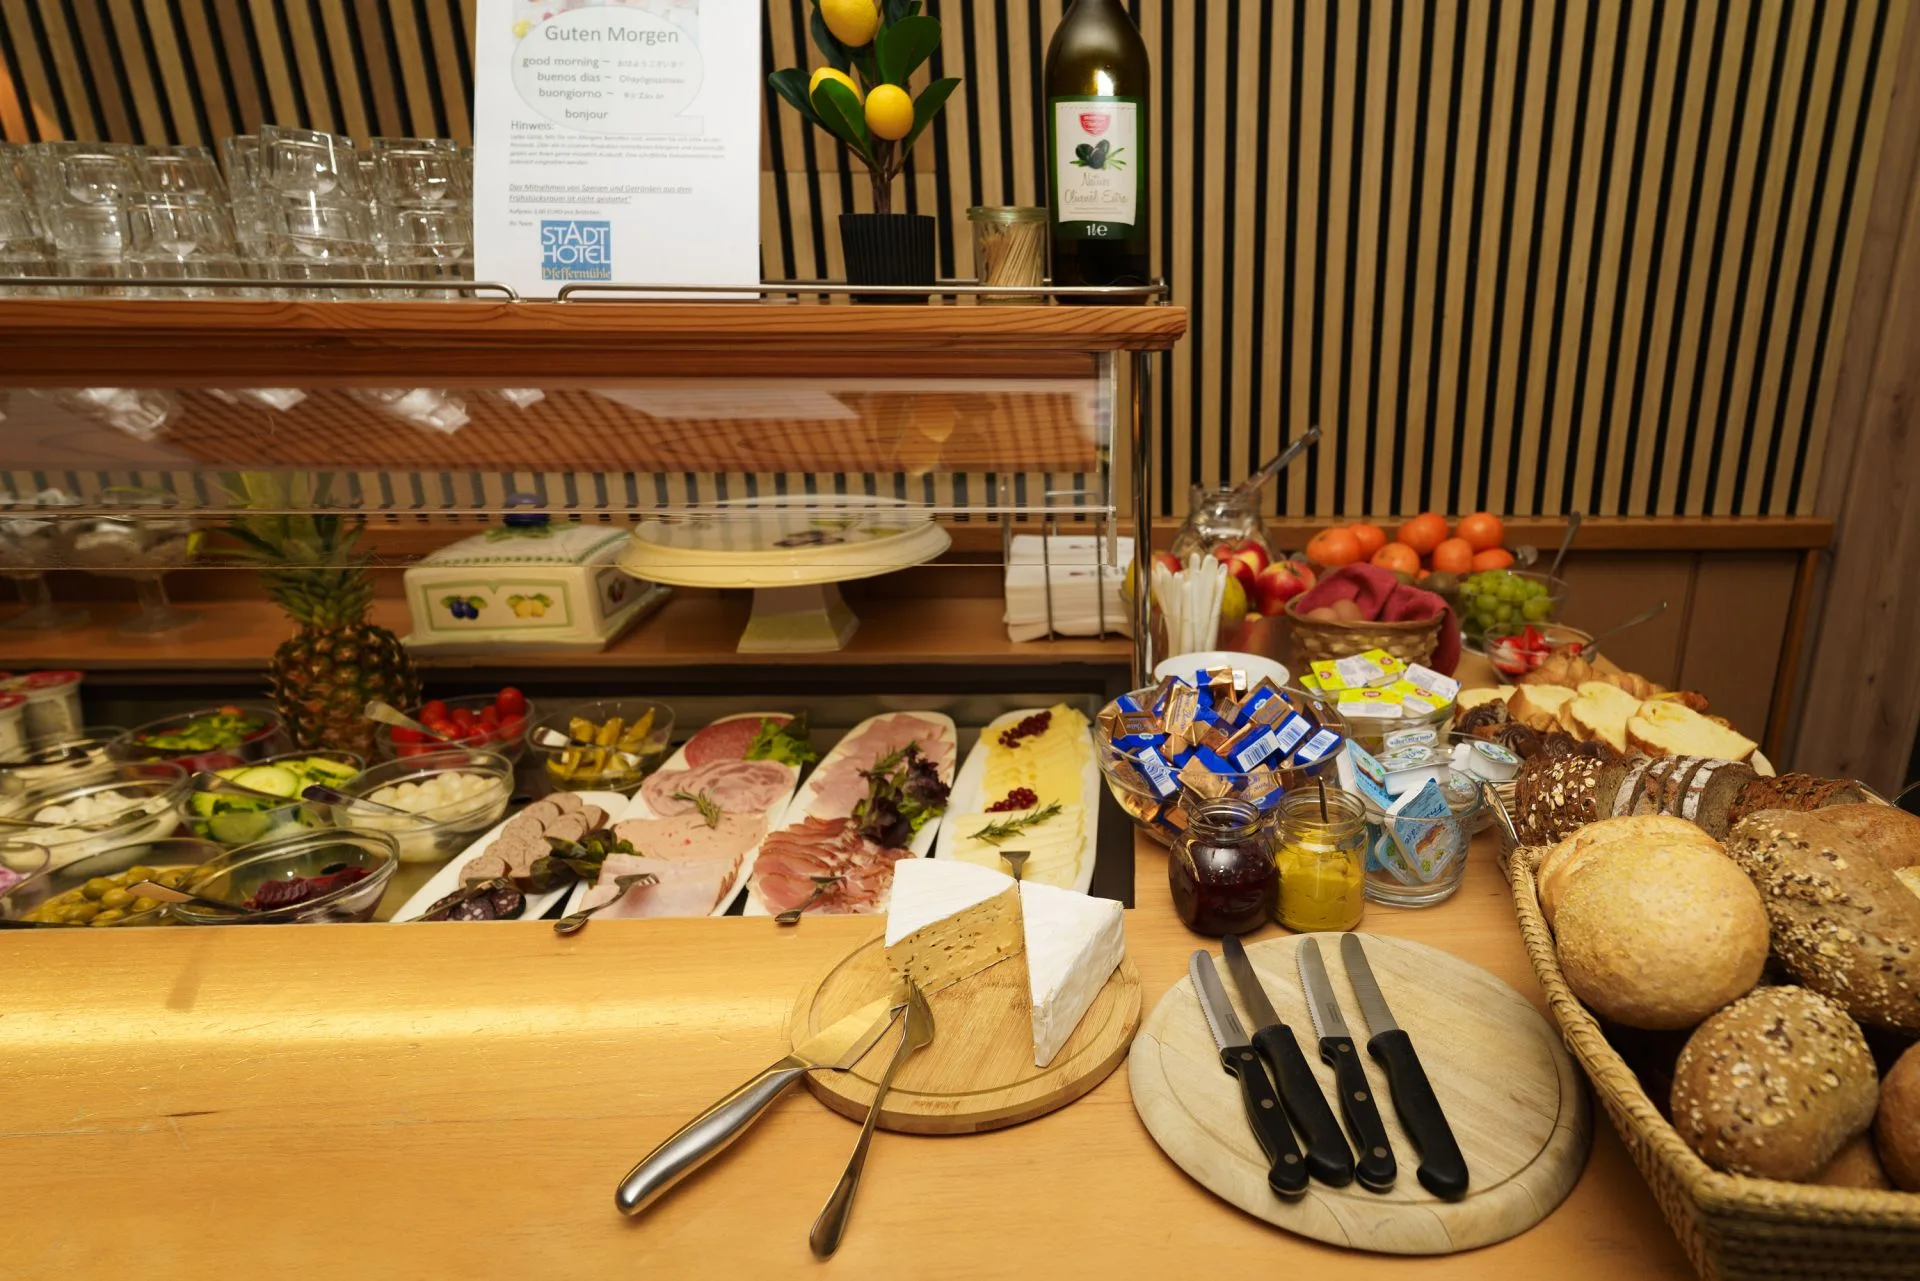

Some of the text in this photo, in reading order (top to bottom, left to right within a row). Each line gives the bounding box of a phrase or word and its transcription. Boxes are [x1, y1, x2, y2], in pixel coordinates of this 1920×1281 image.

[545, 25, 679, 46] Guten Morgen
[522, 57, 600, 69] good morning
[537, 72, 601, 83] buenos dias
[538, 87, 602, 100] buongiorno
[565, 108, 609, 121] bonjour
[510, 120, 555, 131] Hinweis:
[543, 221, 609, 245] STADT
[543, 244, 611, 264] HOTEL
